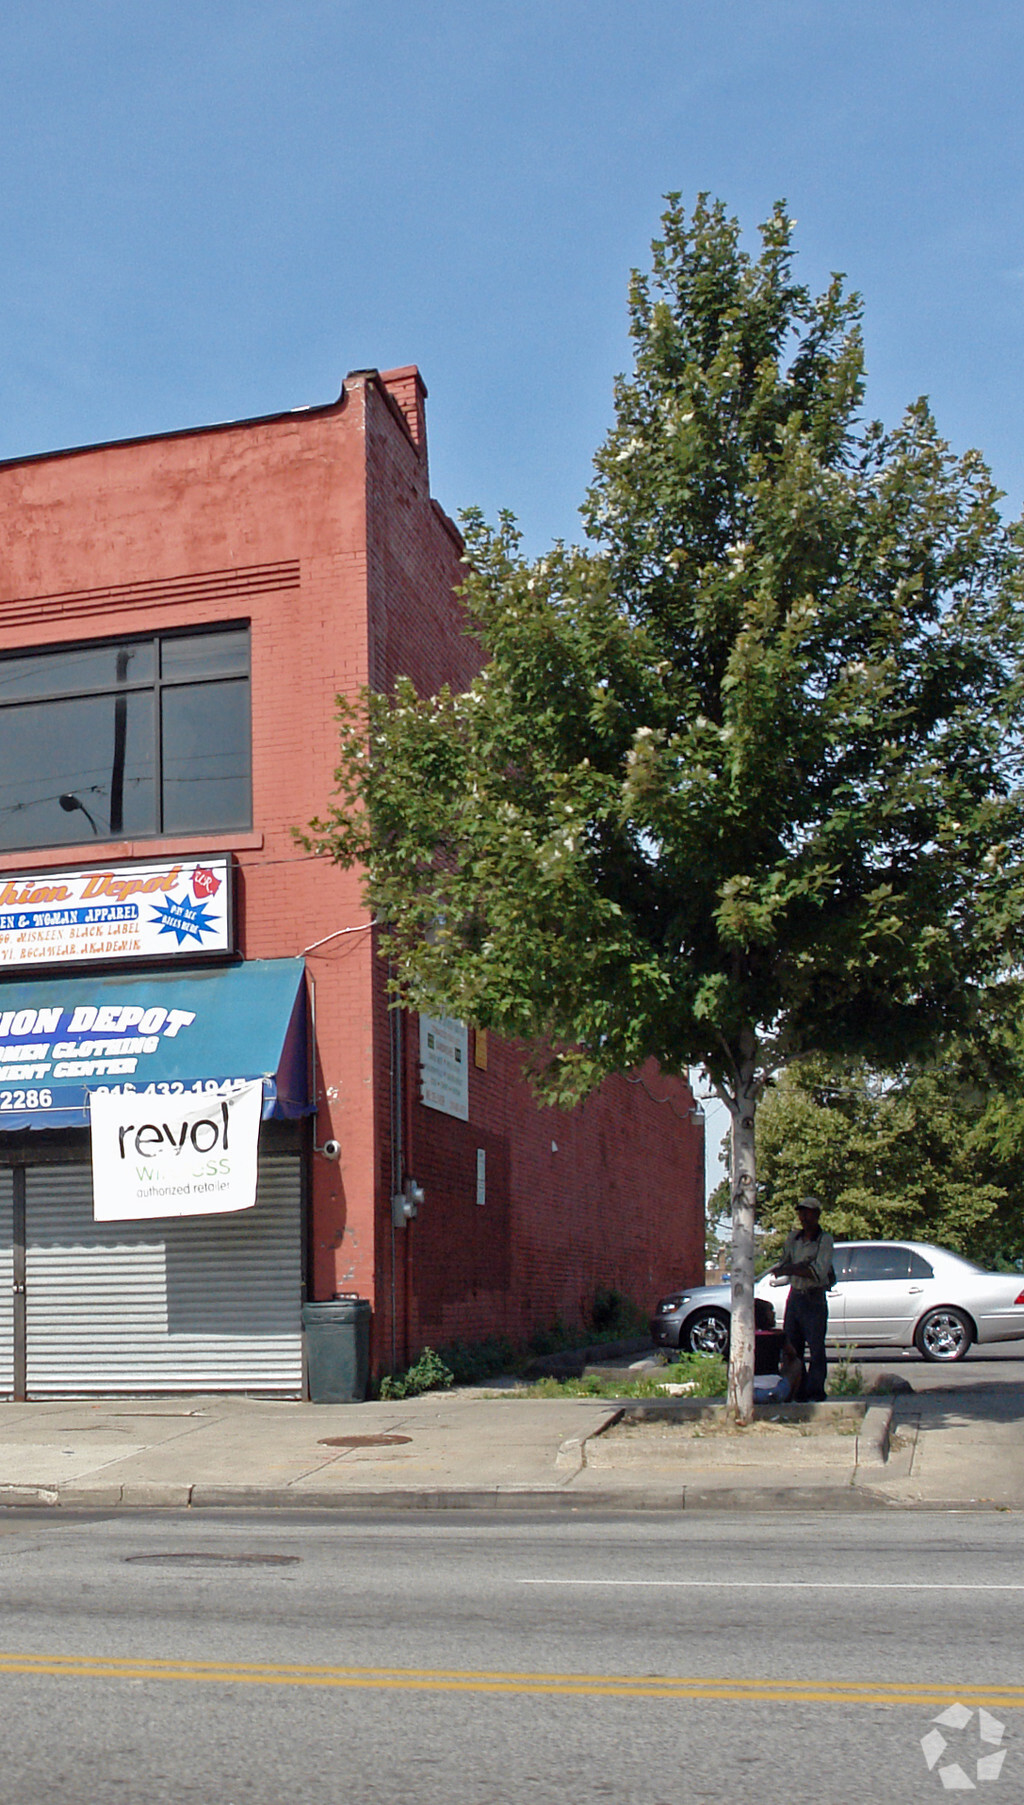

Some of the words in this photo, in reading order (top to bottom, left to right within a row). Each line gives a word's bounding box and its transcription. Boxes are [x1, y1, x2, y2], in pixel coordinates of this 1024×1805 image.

[80, 865, 183, 902] Depot
[18, 914, 30, 928] &
[85, 906, 137, 922] APPAREL
[69, 925, 103, 939] BLACK
[107, 923, 140, 935] LABEL
[66, 1005, 197, 1038] DEPOT
[51, 1035, 160, 1060] CLOTHING
[52, 1057, 138, 1079] CENTER
[0, 1088, 53, 1110] 2286
[119, 1101, 229, 1159] revol
[136, 1183, 191, 1198] authorized
[193, 1180, 230, 1193] retailer
